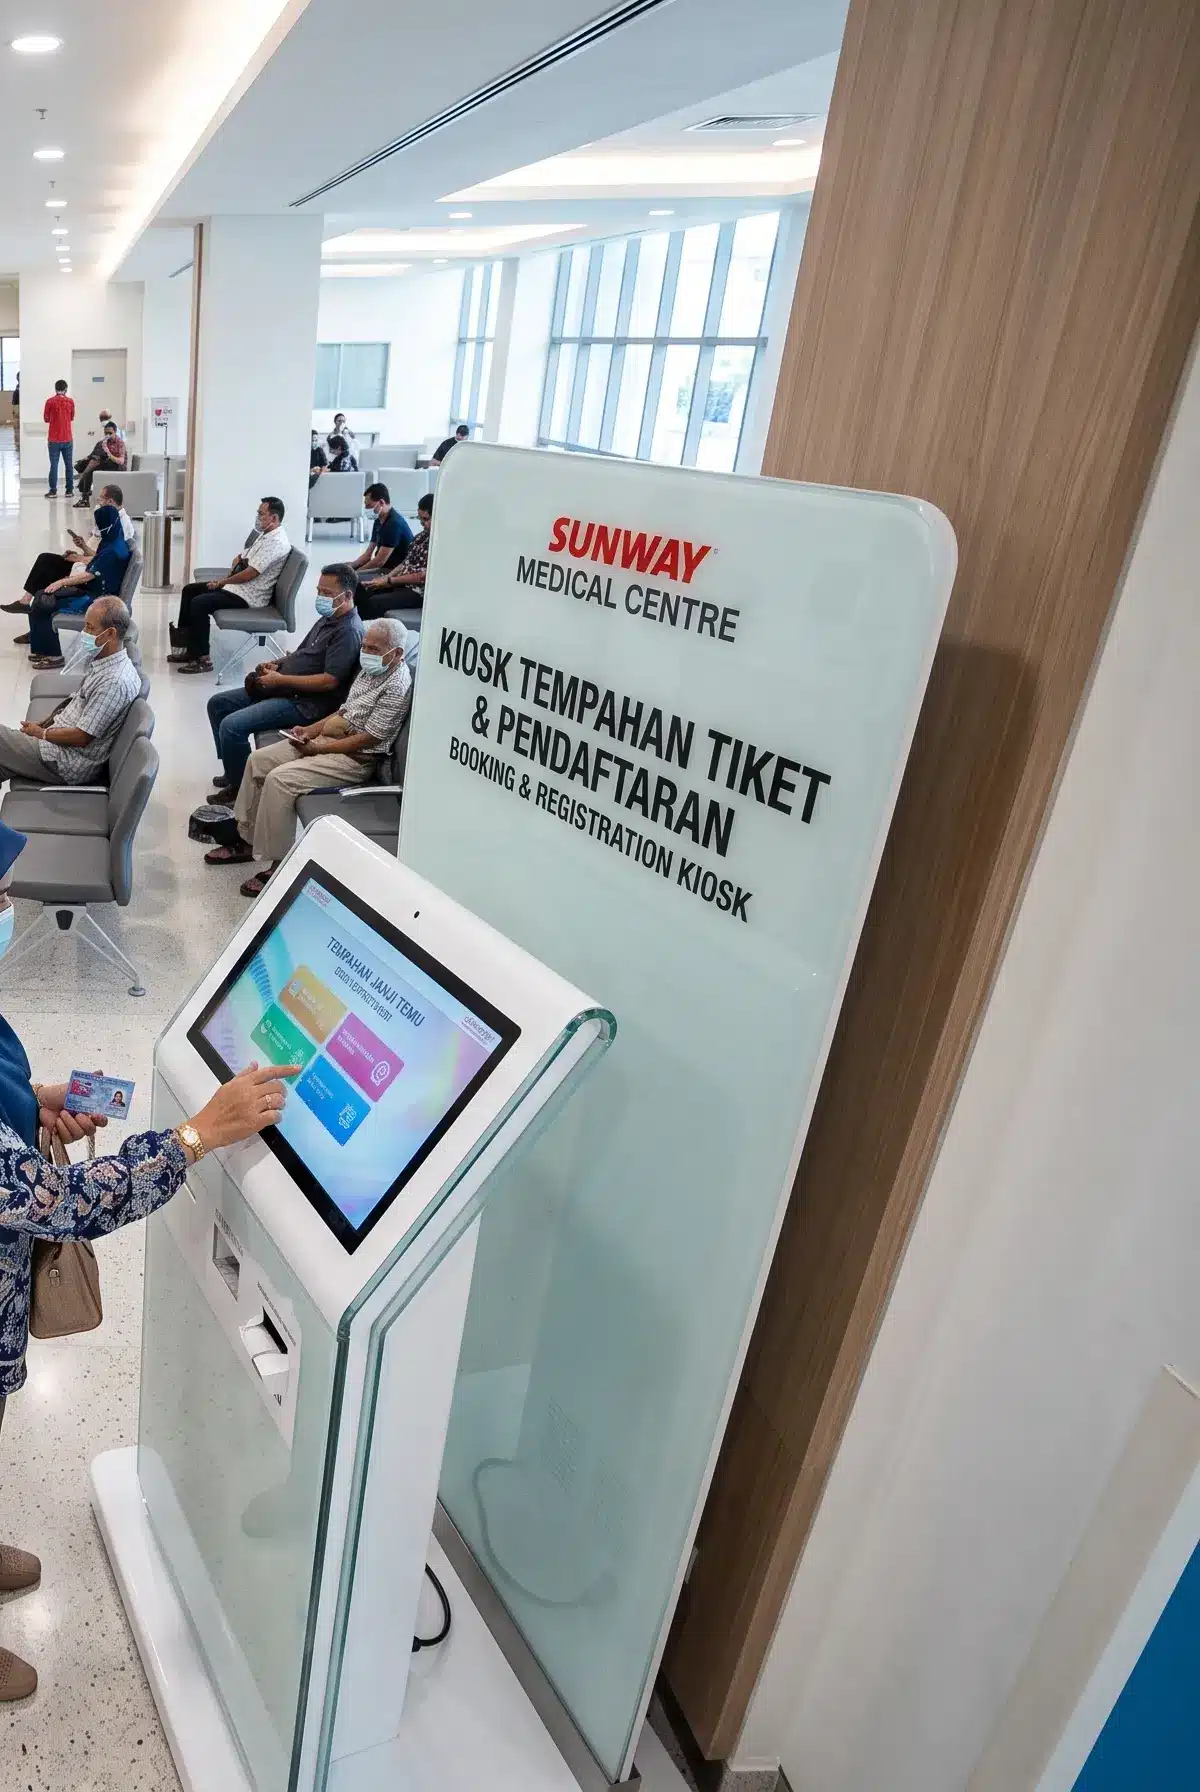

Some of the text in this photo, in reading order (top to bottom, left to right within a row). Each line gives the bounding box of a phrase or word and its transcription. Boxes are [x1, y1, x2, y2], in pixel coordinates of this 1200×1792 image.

[516, 555, 740, 643] MEDICAL CENTRE
[548, 516, 712, 584] SUNWAY
[438, 627, 832, 825] KIOSK TEMPAHAN TIKET
[471, 695, 736, 858] & PENDAFTARAN
[449, 736, 754, 924] BOOKING & REGISTRATION KIOSK
[396, 997, 426, 1027] TEMU
